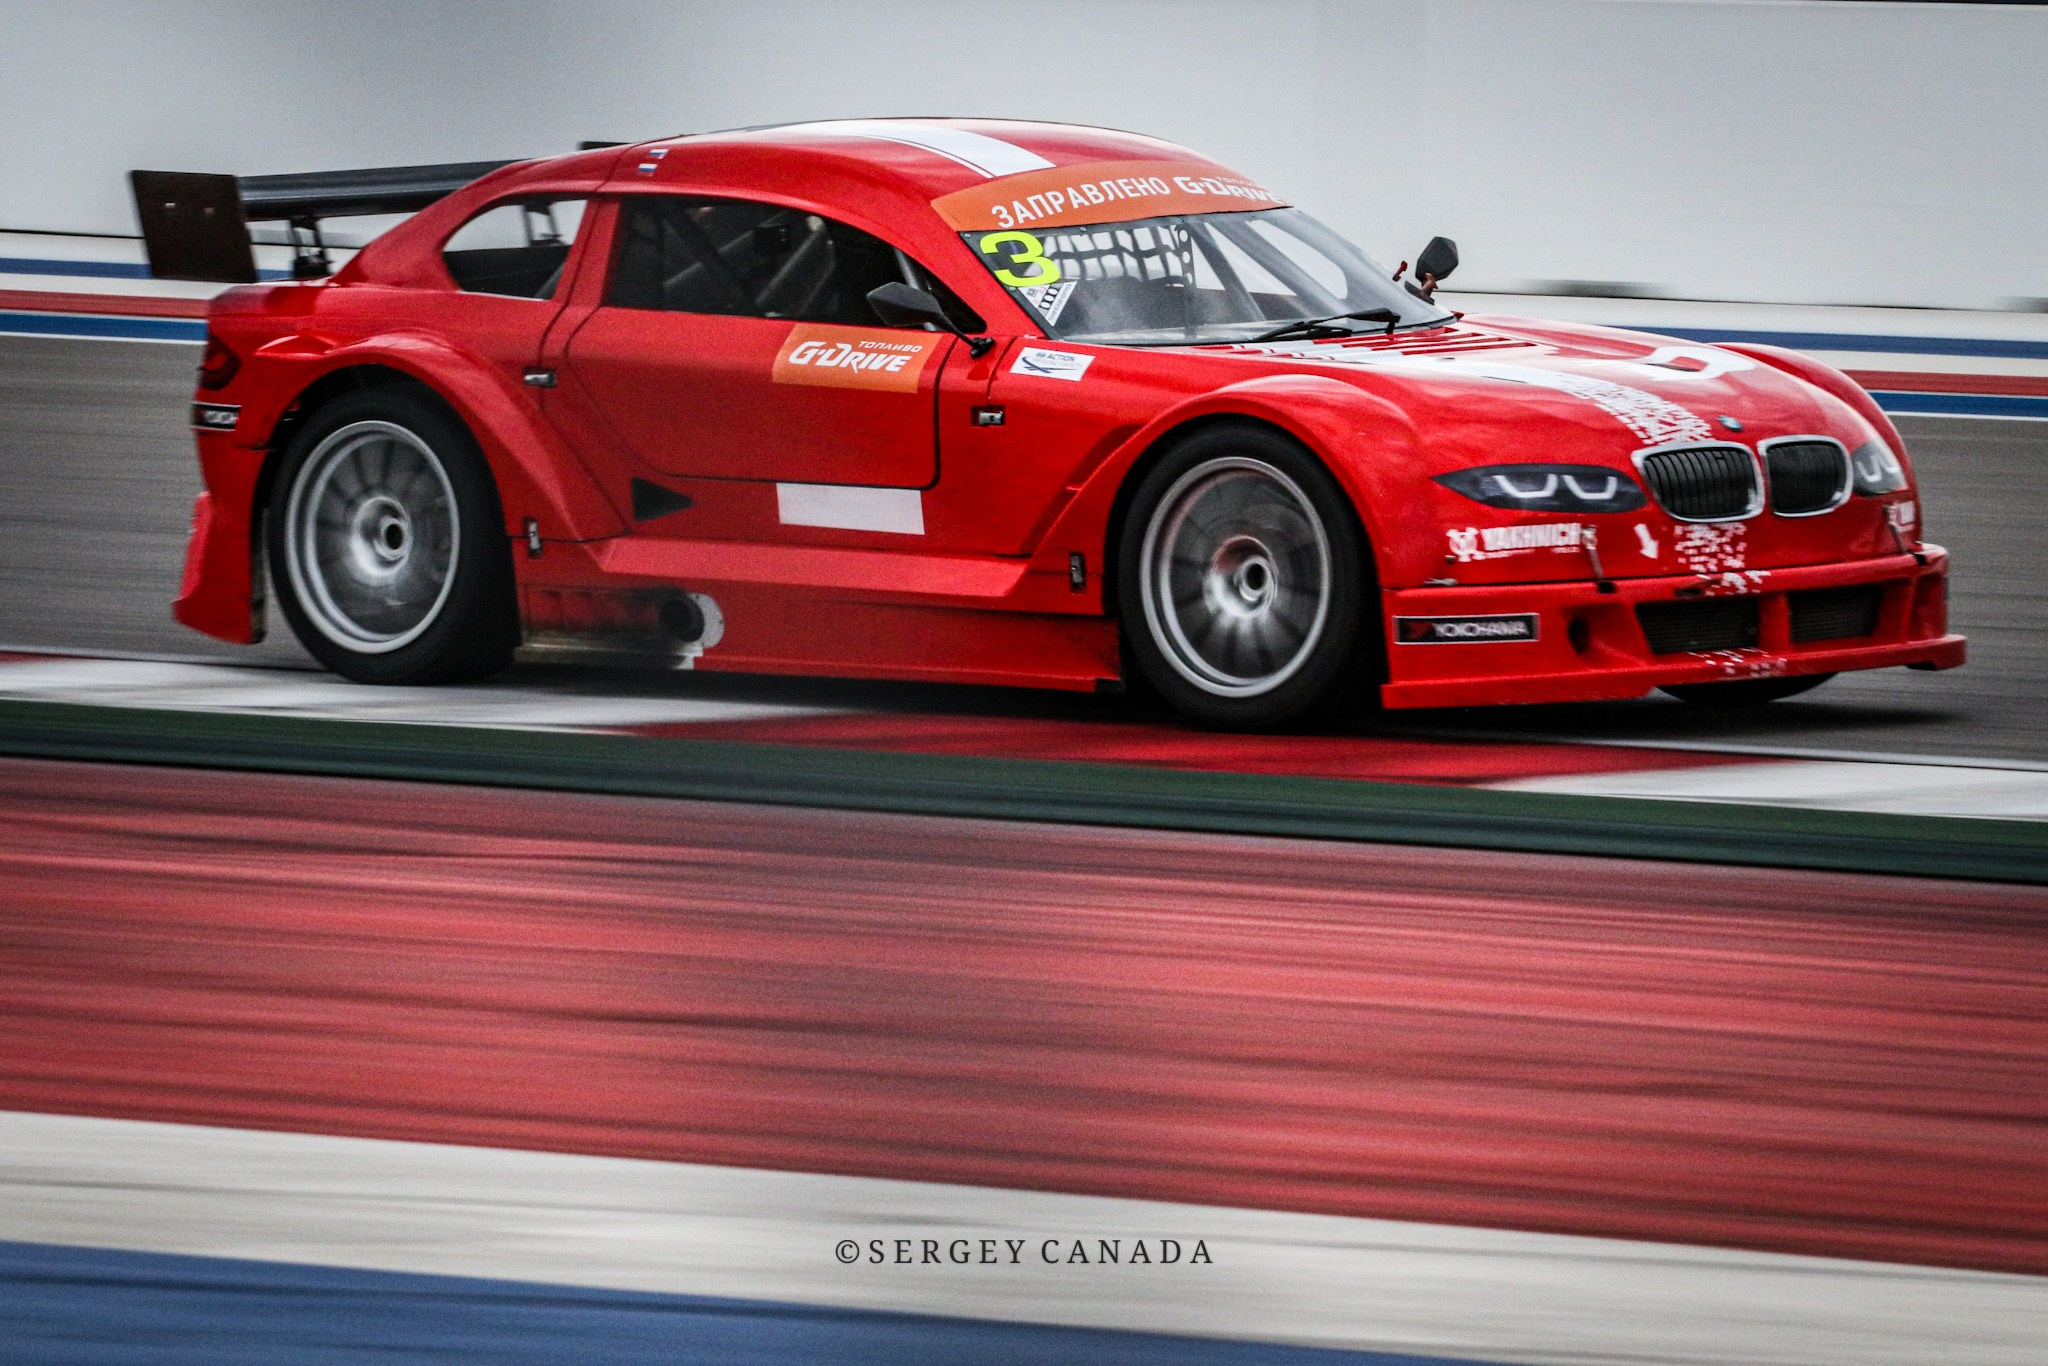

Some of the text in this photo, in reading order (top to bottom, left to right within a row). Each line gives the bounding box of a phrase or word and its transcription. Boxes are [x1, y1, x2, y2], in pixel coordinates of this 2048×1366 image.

[991, 177, 1171, 229] ЗАПРАВЛЕНО
[980, 231, 1060, 288] 3
[858, 340, 923, 353] ТОПЛИВО
